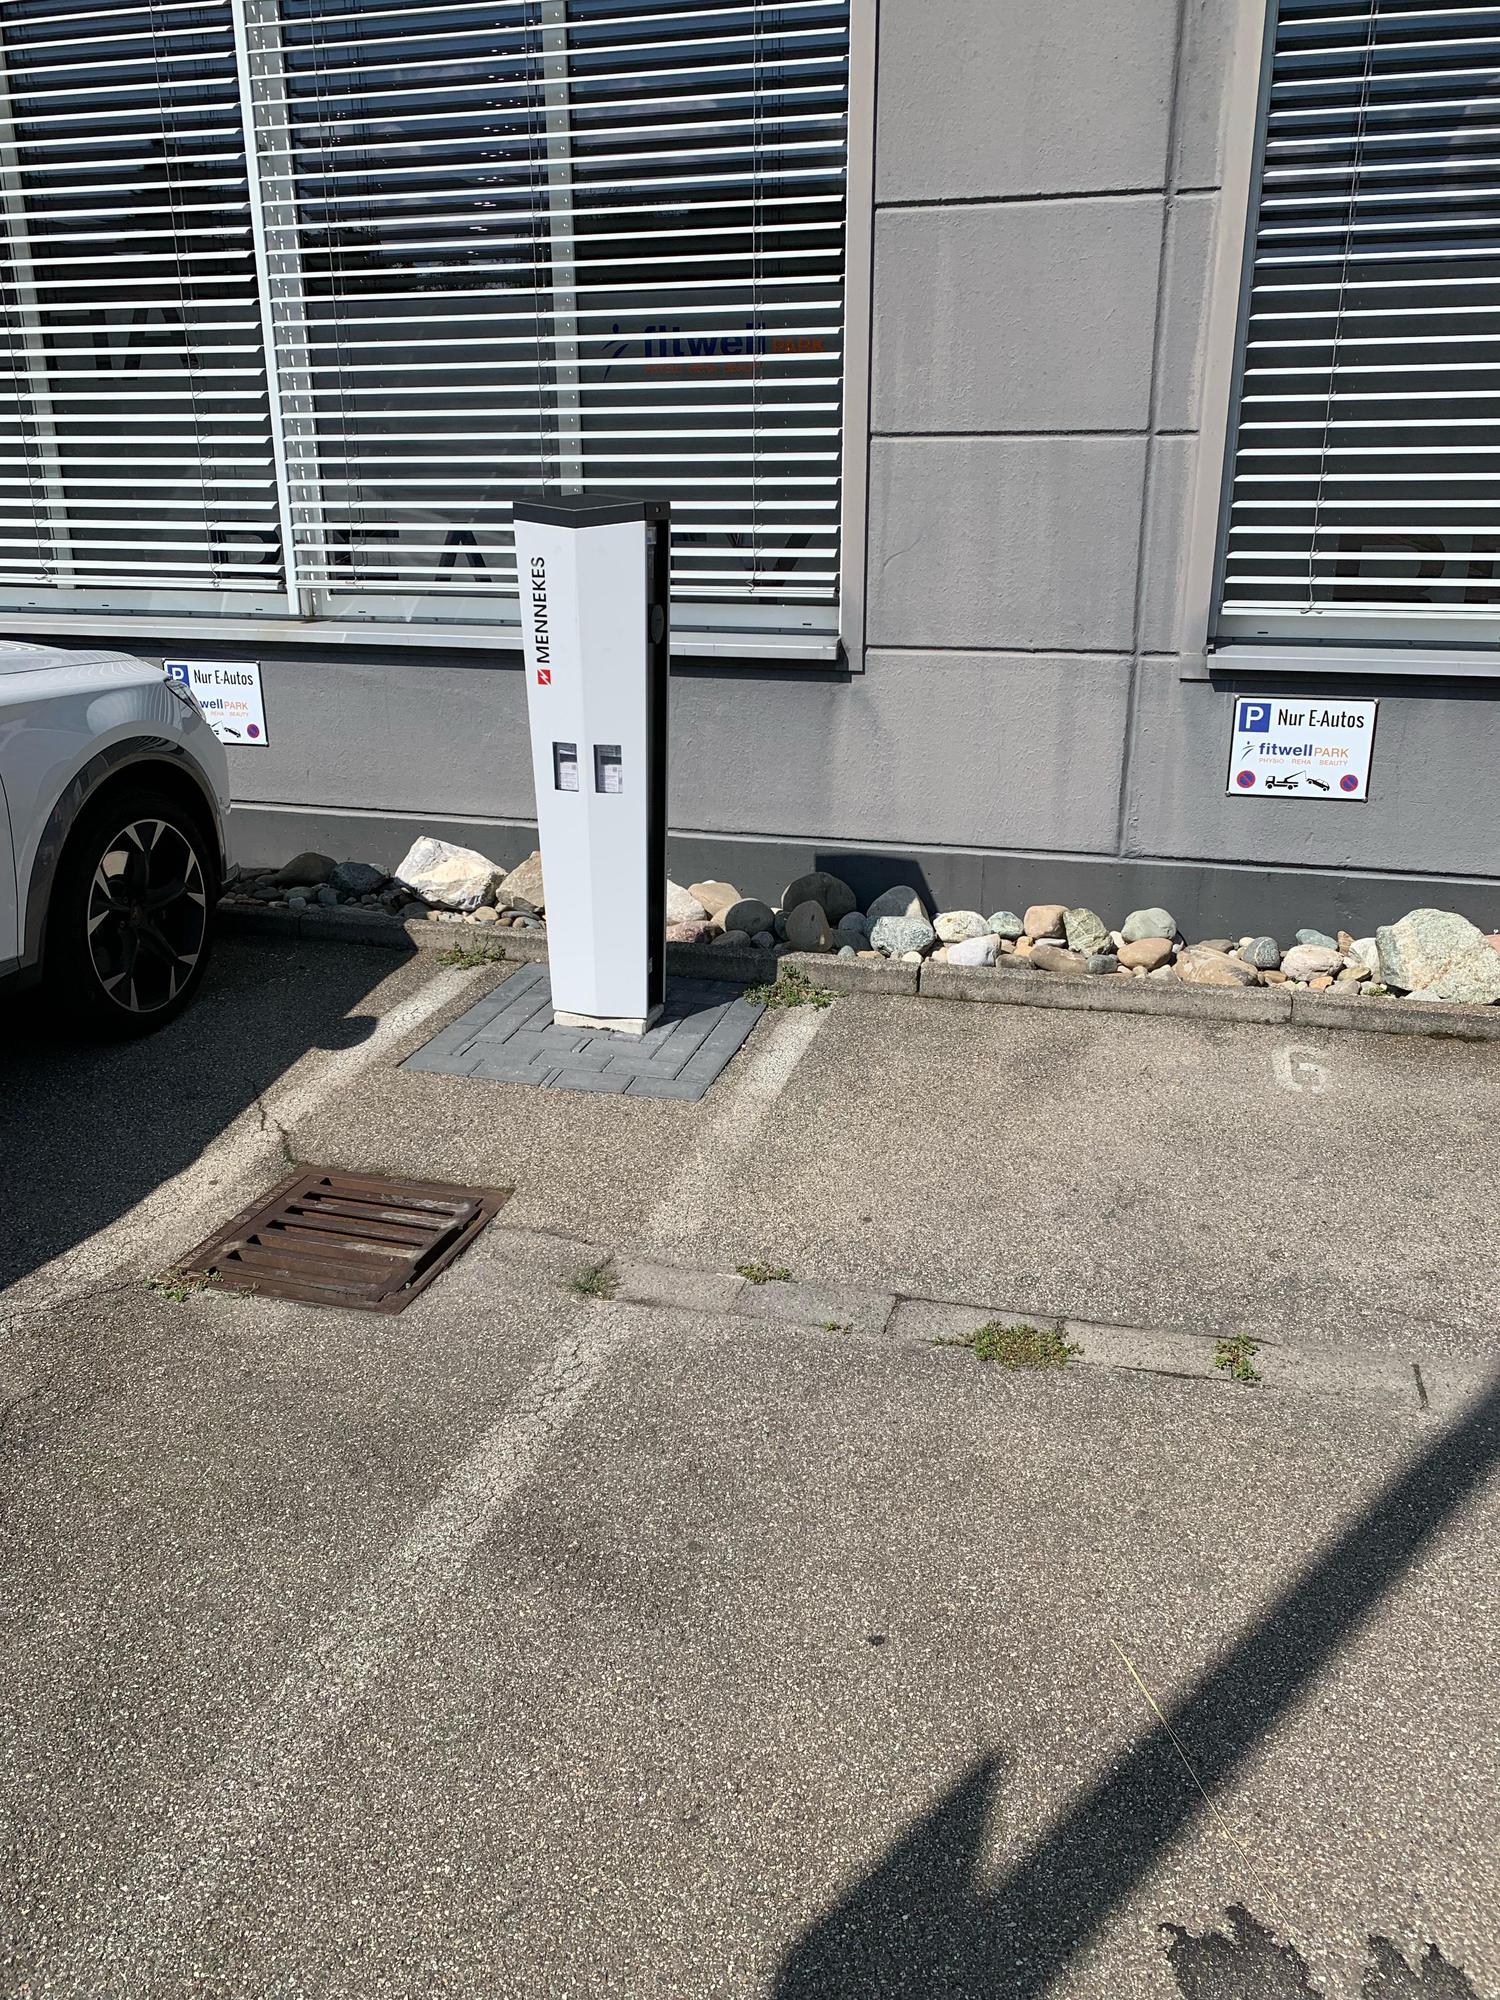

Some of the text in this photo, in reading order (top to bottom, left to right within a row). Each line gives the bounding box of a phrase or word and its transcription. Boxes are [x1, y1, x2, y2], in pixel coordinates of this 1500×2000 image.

[531, 556, 550, 664] MENNEKES
[194, 669, 212, 684] Nur
[215, 670, 254, 685] E-Autos
[1246, 706, 1364, 729] P Nur E-Autos
[1291, 758, 1312, 766] REHA
[1319, 759, 1348, 767] BEAUTY
